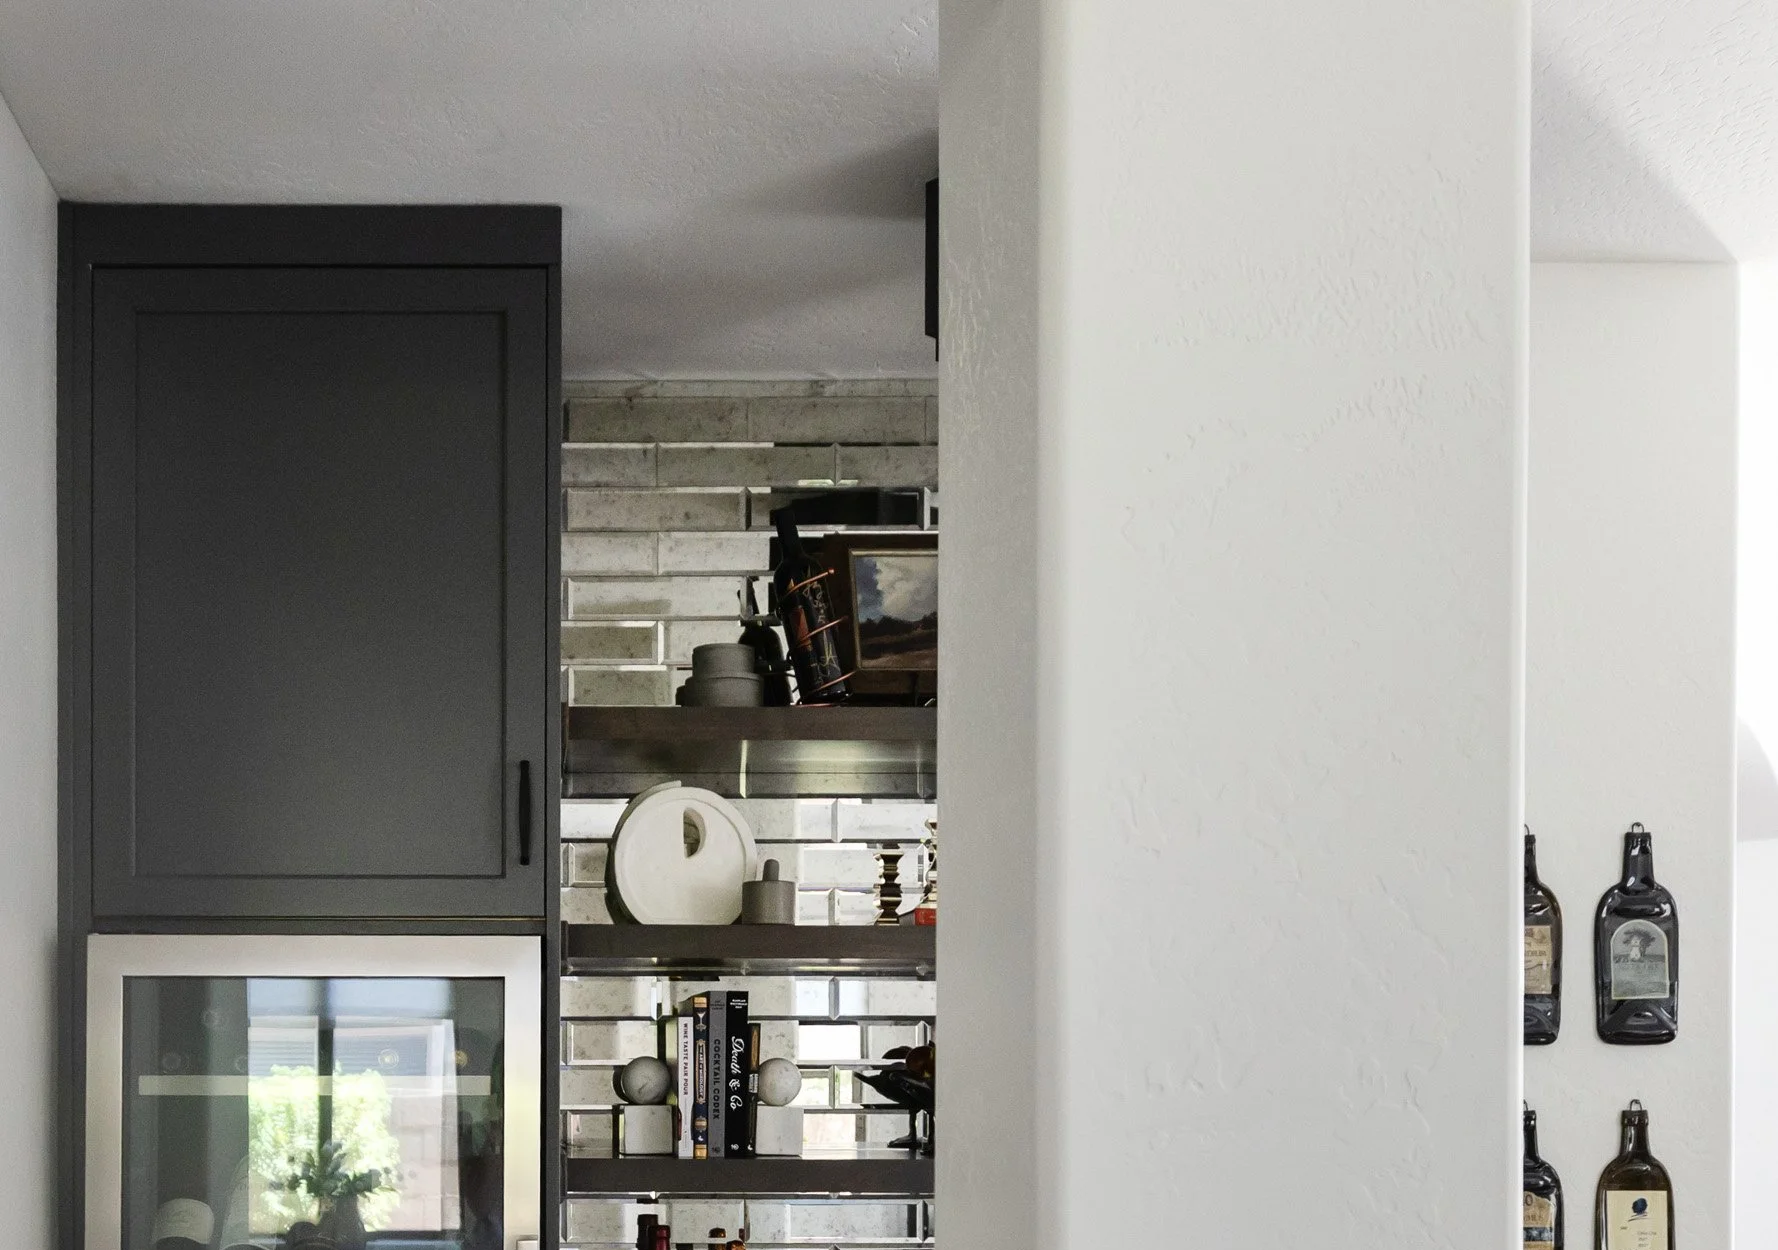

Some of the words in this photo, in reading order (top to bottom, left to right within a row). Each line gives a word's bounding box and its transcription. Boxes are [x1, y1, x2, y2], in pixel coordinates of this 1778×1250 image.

[713, 1038, 721, 1086] COCKTAIL
[730, 1035, 745, 1074] Death
[729, 1078, 741, 1091] &
[730, 1095, 743, 1111] Co
